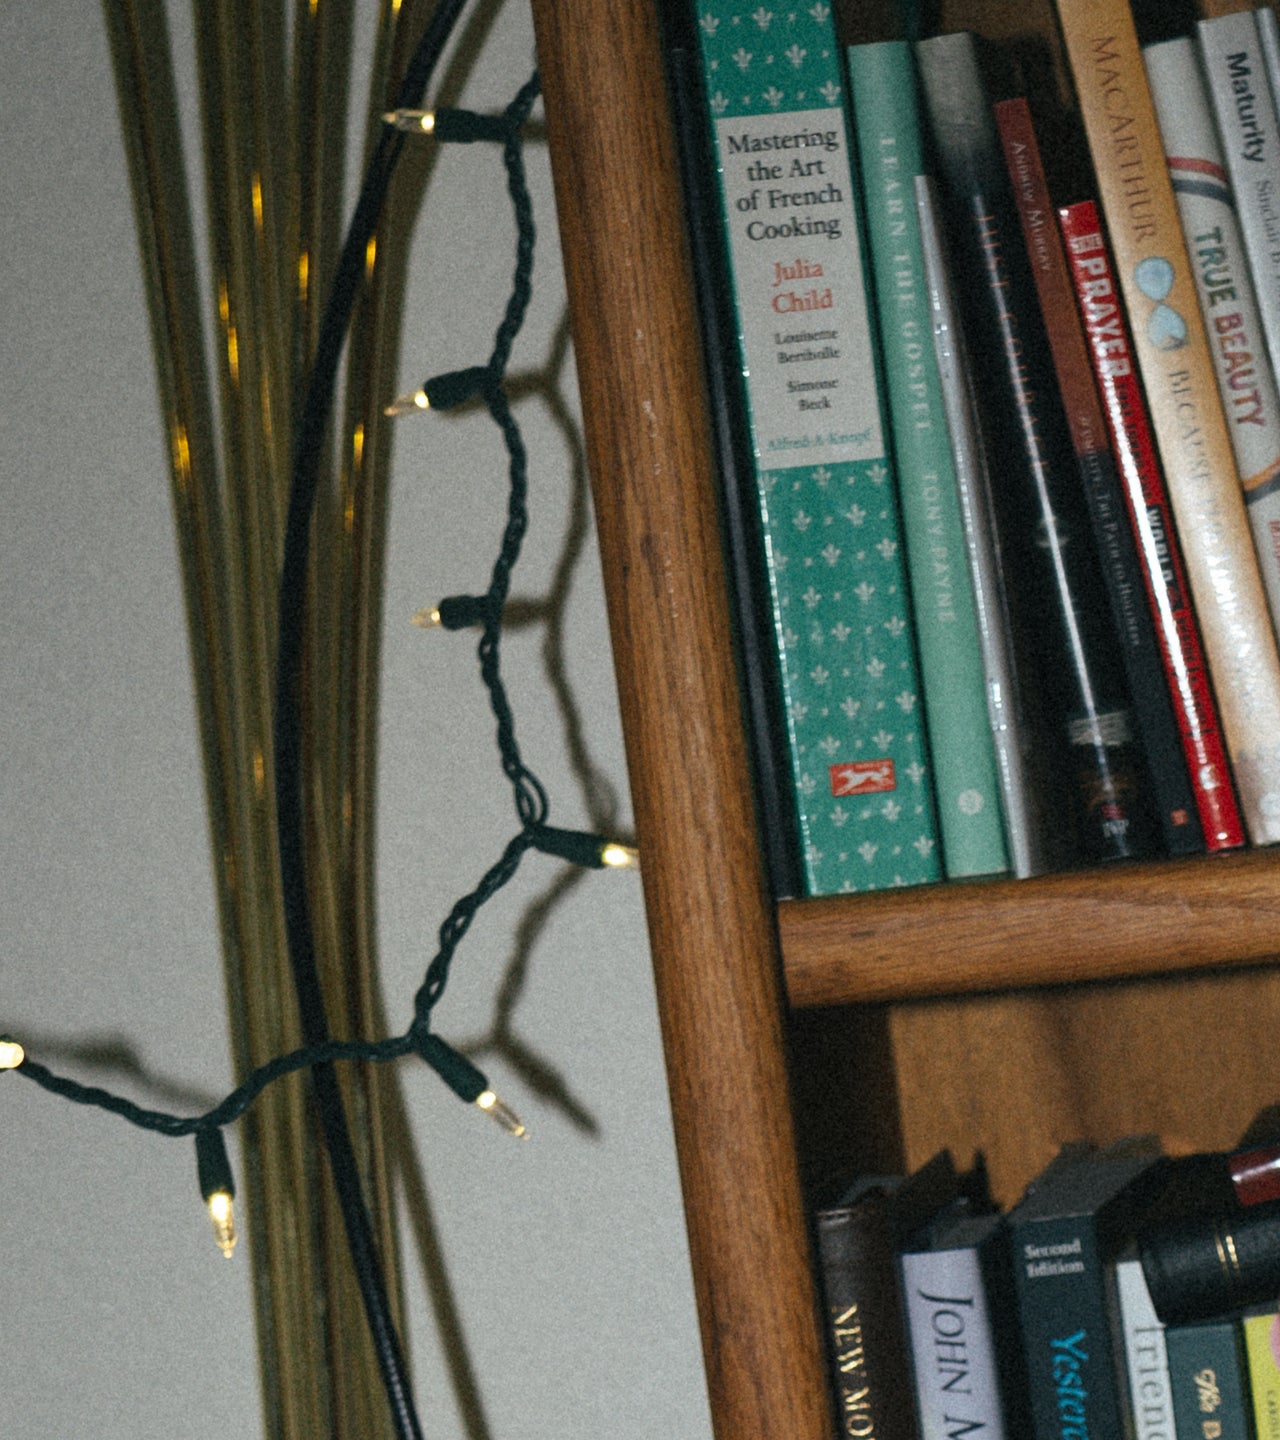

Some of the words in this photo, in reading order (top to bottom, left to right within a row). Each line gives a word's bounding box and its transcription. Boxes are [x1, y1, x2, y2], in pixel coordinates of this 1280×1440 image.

[1222, 50, 1269, 165] Maturity
[728, 127, 839, 155] Mastering
[747, 161, 782, 182] the
[789, 158, 825, 179] Art
[736, 190, 761, 213] of
[767, 184, 843, 209] French
[746, 215, 842, 242] Cooking
[772, 259, 824, 287] Julia
[1192, 226, 1236, 306] TRUE
[771, 289, 833, 314] Child
[788, 377, 838, 393] Simone
[1212, 312, 1264, 430] BEAUTY
[1025, 1238, 1081, 1259] Second
[1027, 1260, 1085, 1278] Edition
[830, 1301, 868, 1380] NEW
[916, 1283, 984, 1400] JOHN
